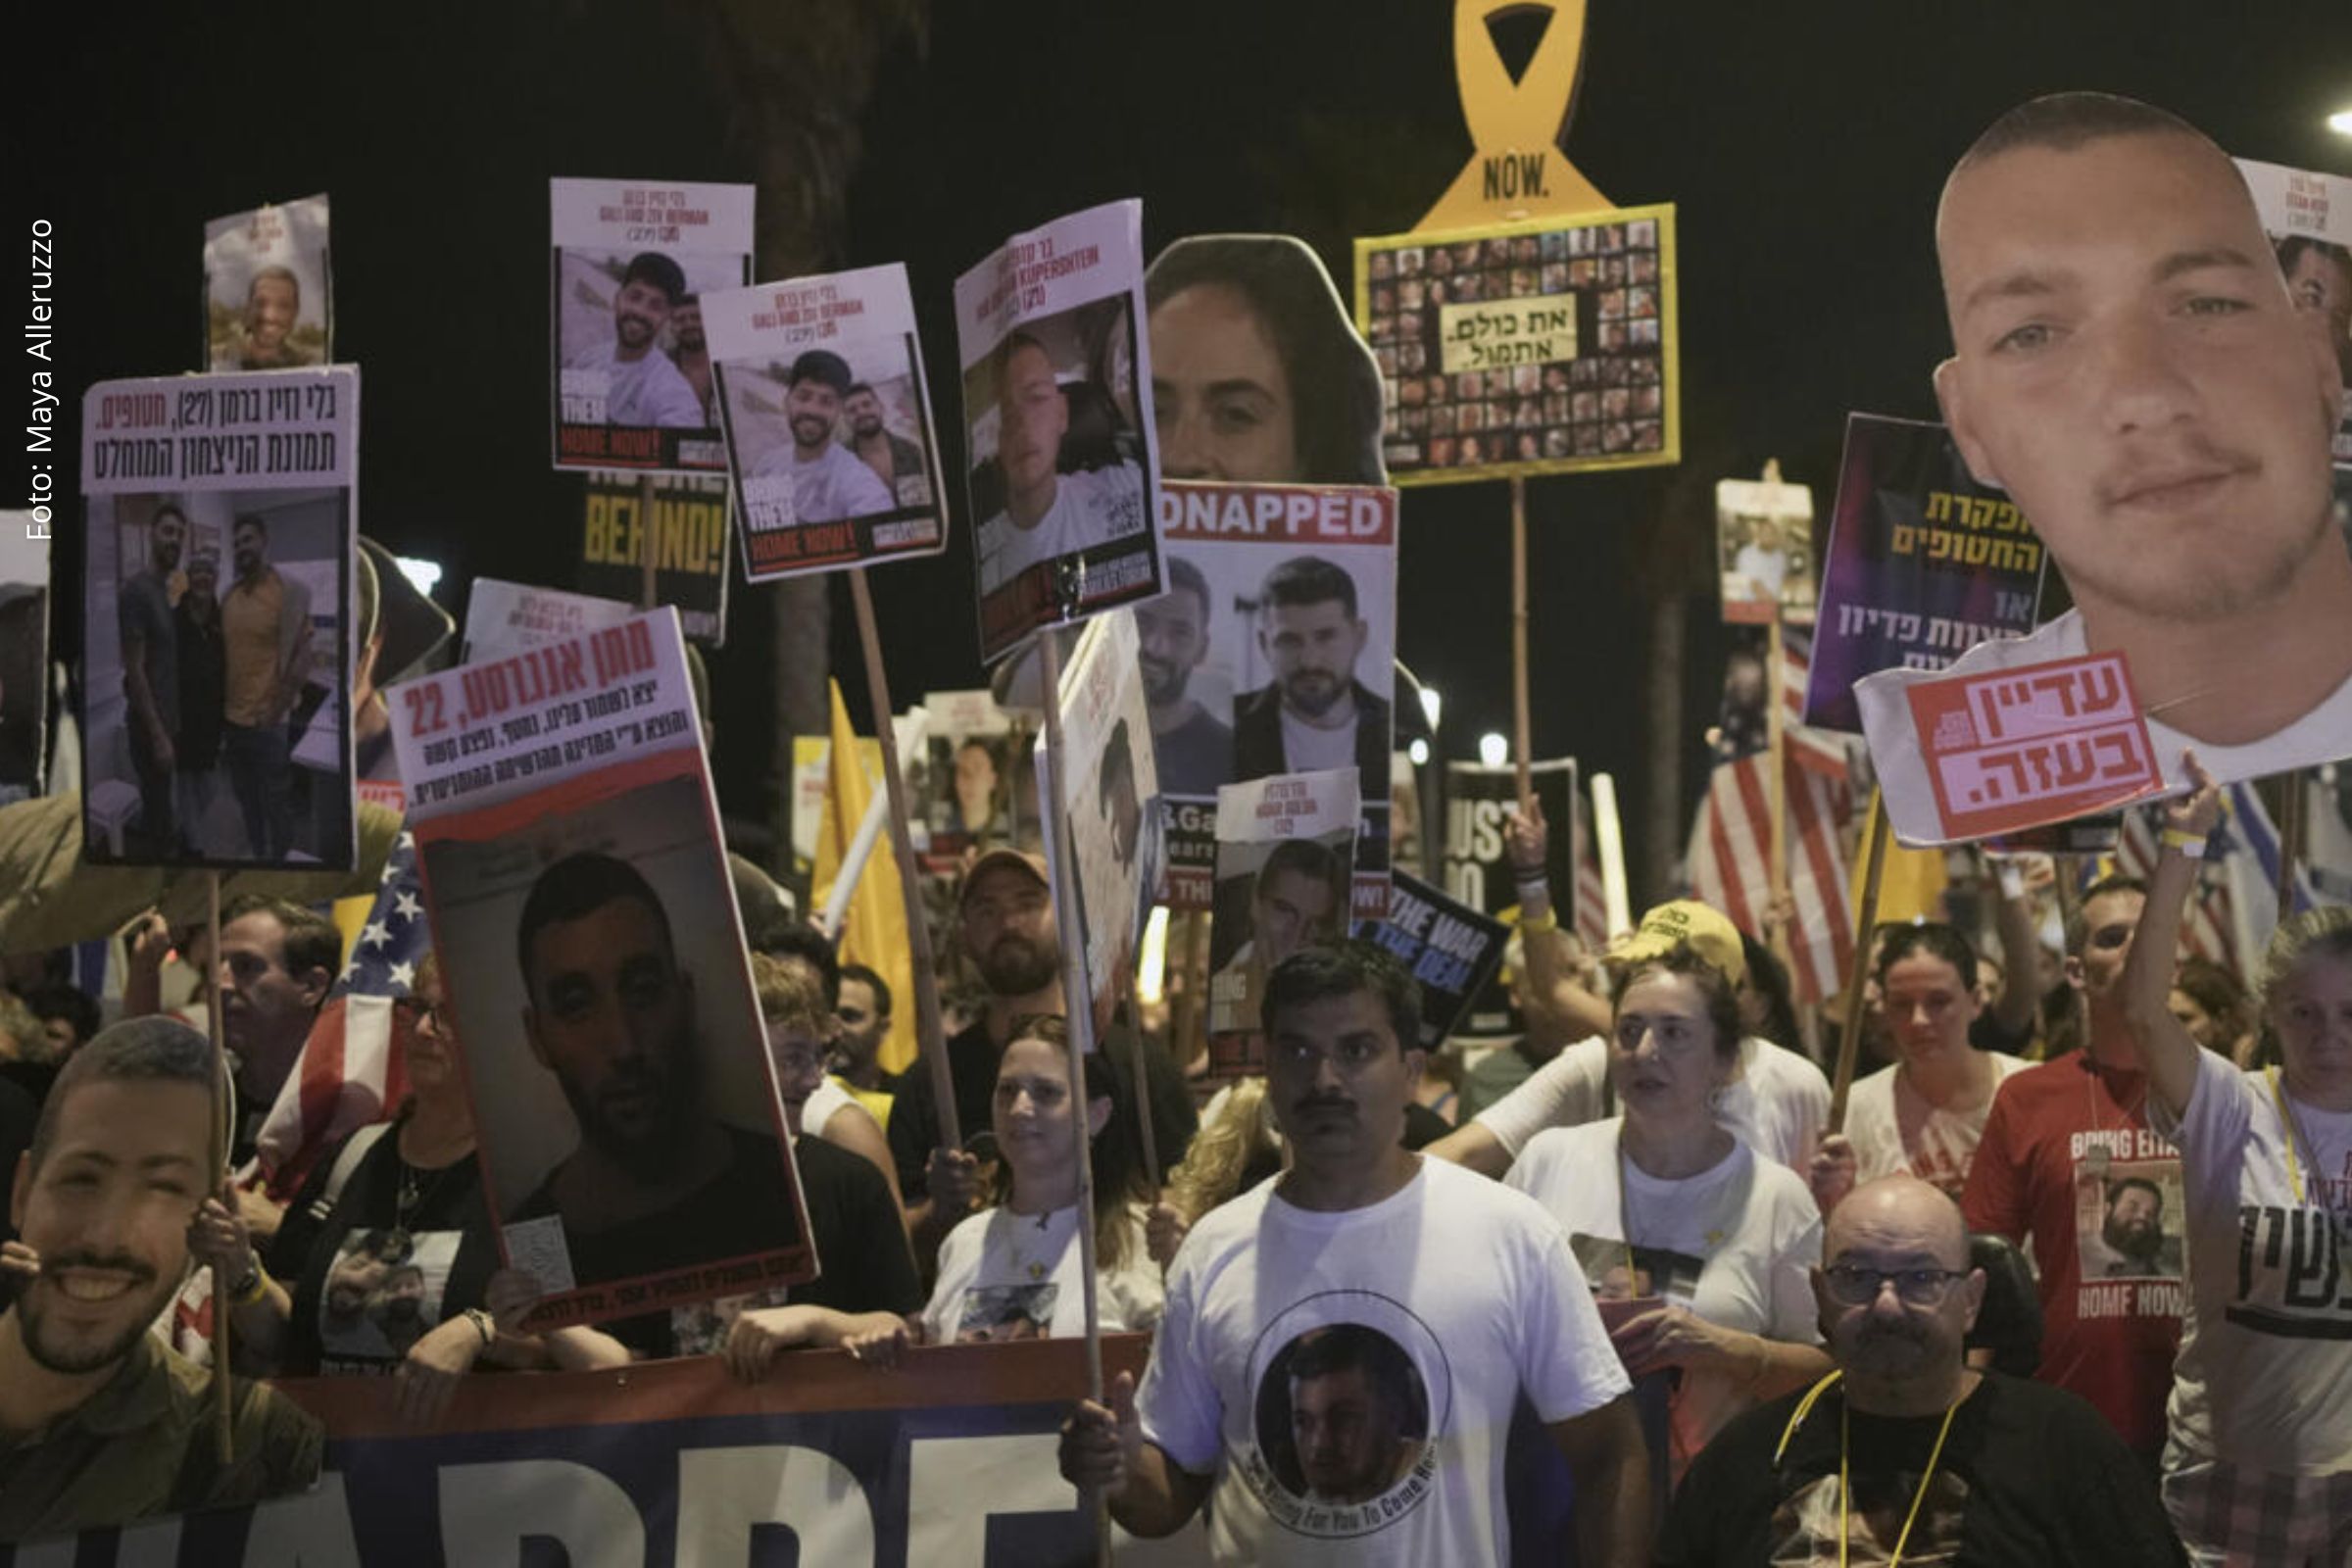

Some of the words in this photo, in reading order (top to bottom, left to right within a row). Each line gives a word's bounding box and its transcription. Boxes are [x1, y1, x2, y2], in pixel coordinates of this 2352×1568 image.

[1483, 153, 1549, 202] NOW.
[1446, 311, 1516, 343] כולם.
[1528, 309, 1567, 333] את
[95, 392, 167, 430] חטופים.
[220, 387, 261, 427] ברמן
[269, 385, 300, 421] וזיו
[307, 383, 335, 420] גלי
[95, 438, 172, 479] המוחלט
[181, 434, 260, 480] הניצחון
[266, 431, 335, 473] תמונת
[585, 494, 723, 575] BEHIND!
[1161, 492, 1383, 536] DNAPPED
[1891, 523, 2039, 572] החטופים
[1838, 604, 1921, 641] פדיון
[1994, 591, 2032, 621] או
[591, 618, 657, 689] מתן
[404, 682, 447, 738] 22
[1979, 665, 2121, 738] עדיין
[1968, 731, 2144, 803] בעזה.
[1179, 806, 1216, 831] Ga
[1429, 913, 1490, 963] WAR
[2137, 1130, 2180, 1158] EITA
[2238, 1206, 2352, 1309] שיו
[2078, 1285, 2132, 1319] HOME
[1380, 1477, 1424, 1517] Come
